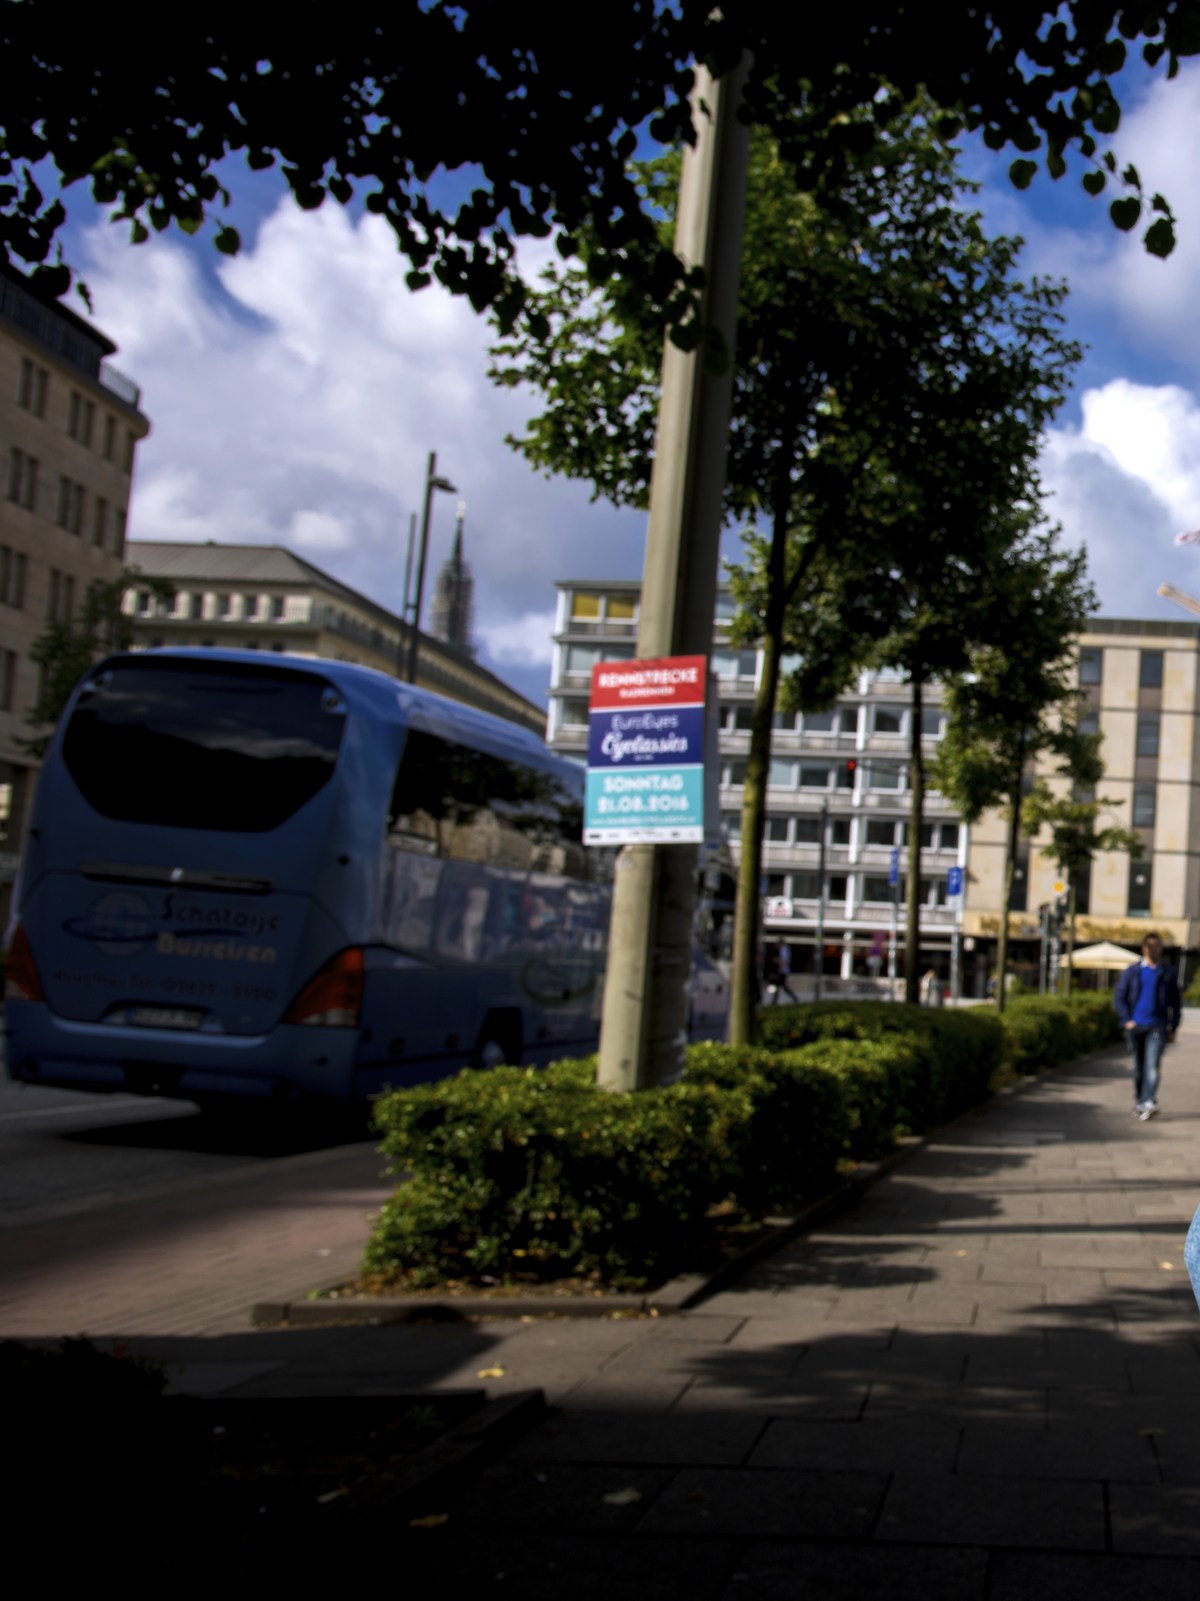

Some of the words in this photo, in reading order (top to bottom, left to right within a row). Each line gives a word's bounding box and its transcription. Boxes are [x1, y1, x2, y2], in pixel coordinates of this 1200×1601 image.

[599, 668, 699, 687] RENNSTRECKE
[611, 713, 680, 731] EuroEyes
[603, 775, 684, 793] SONNTAG
